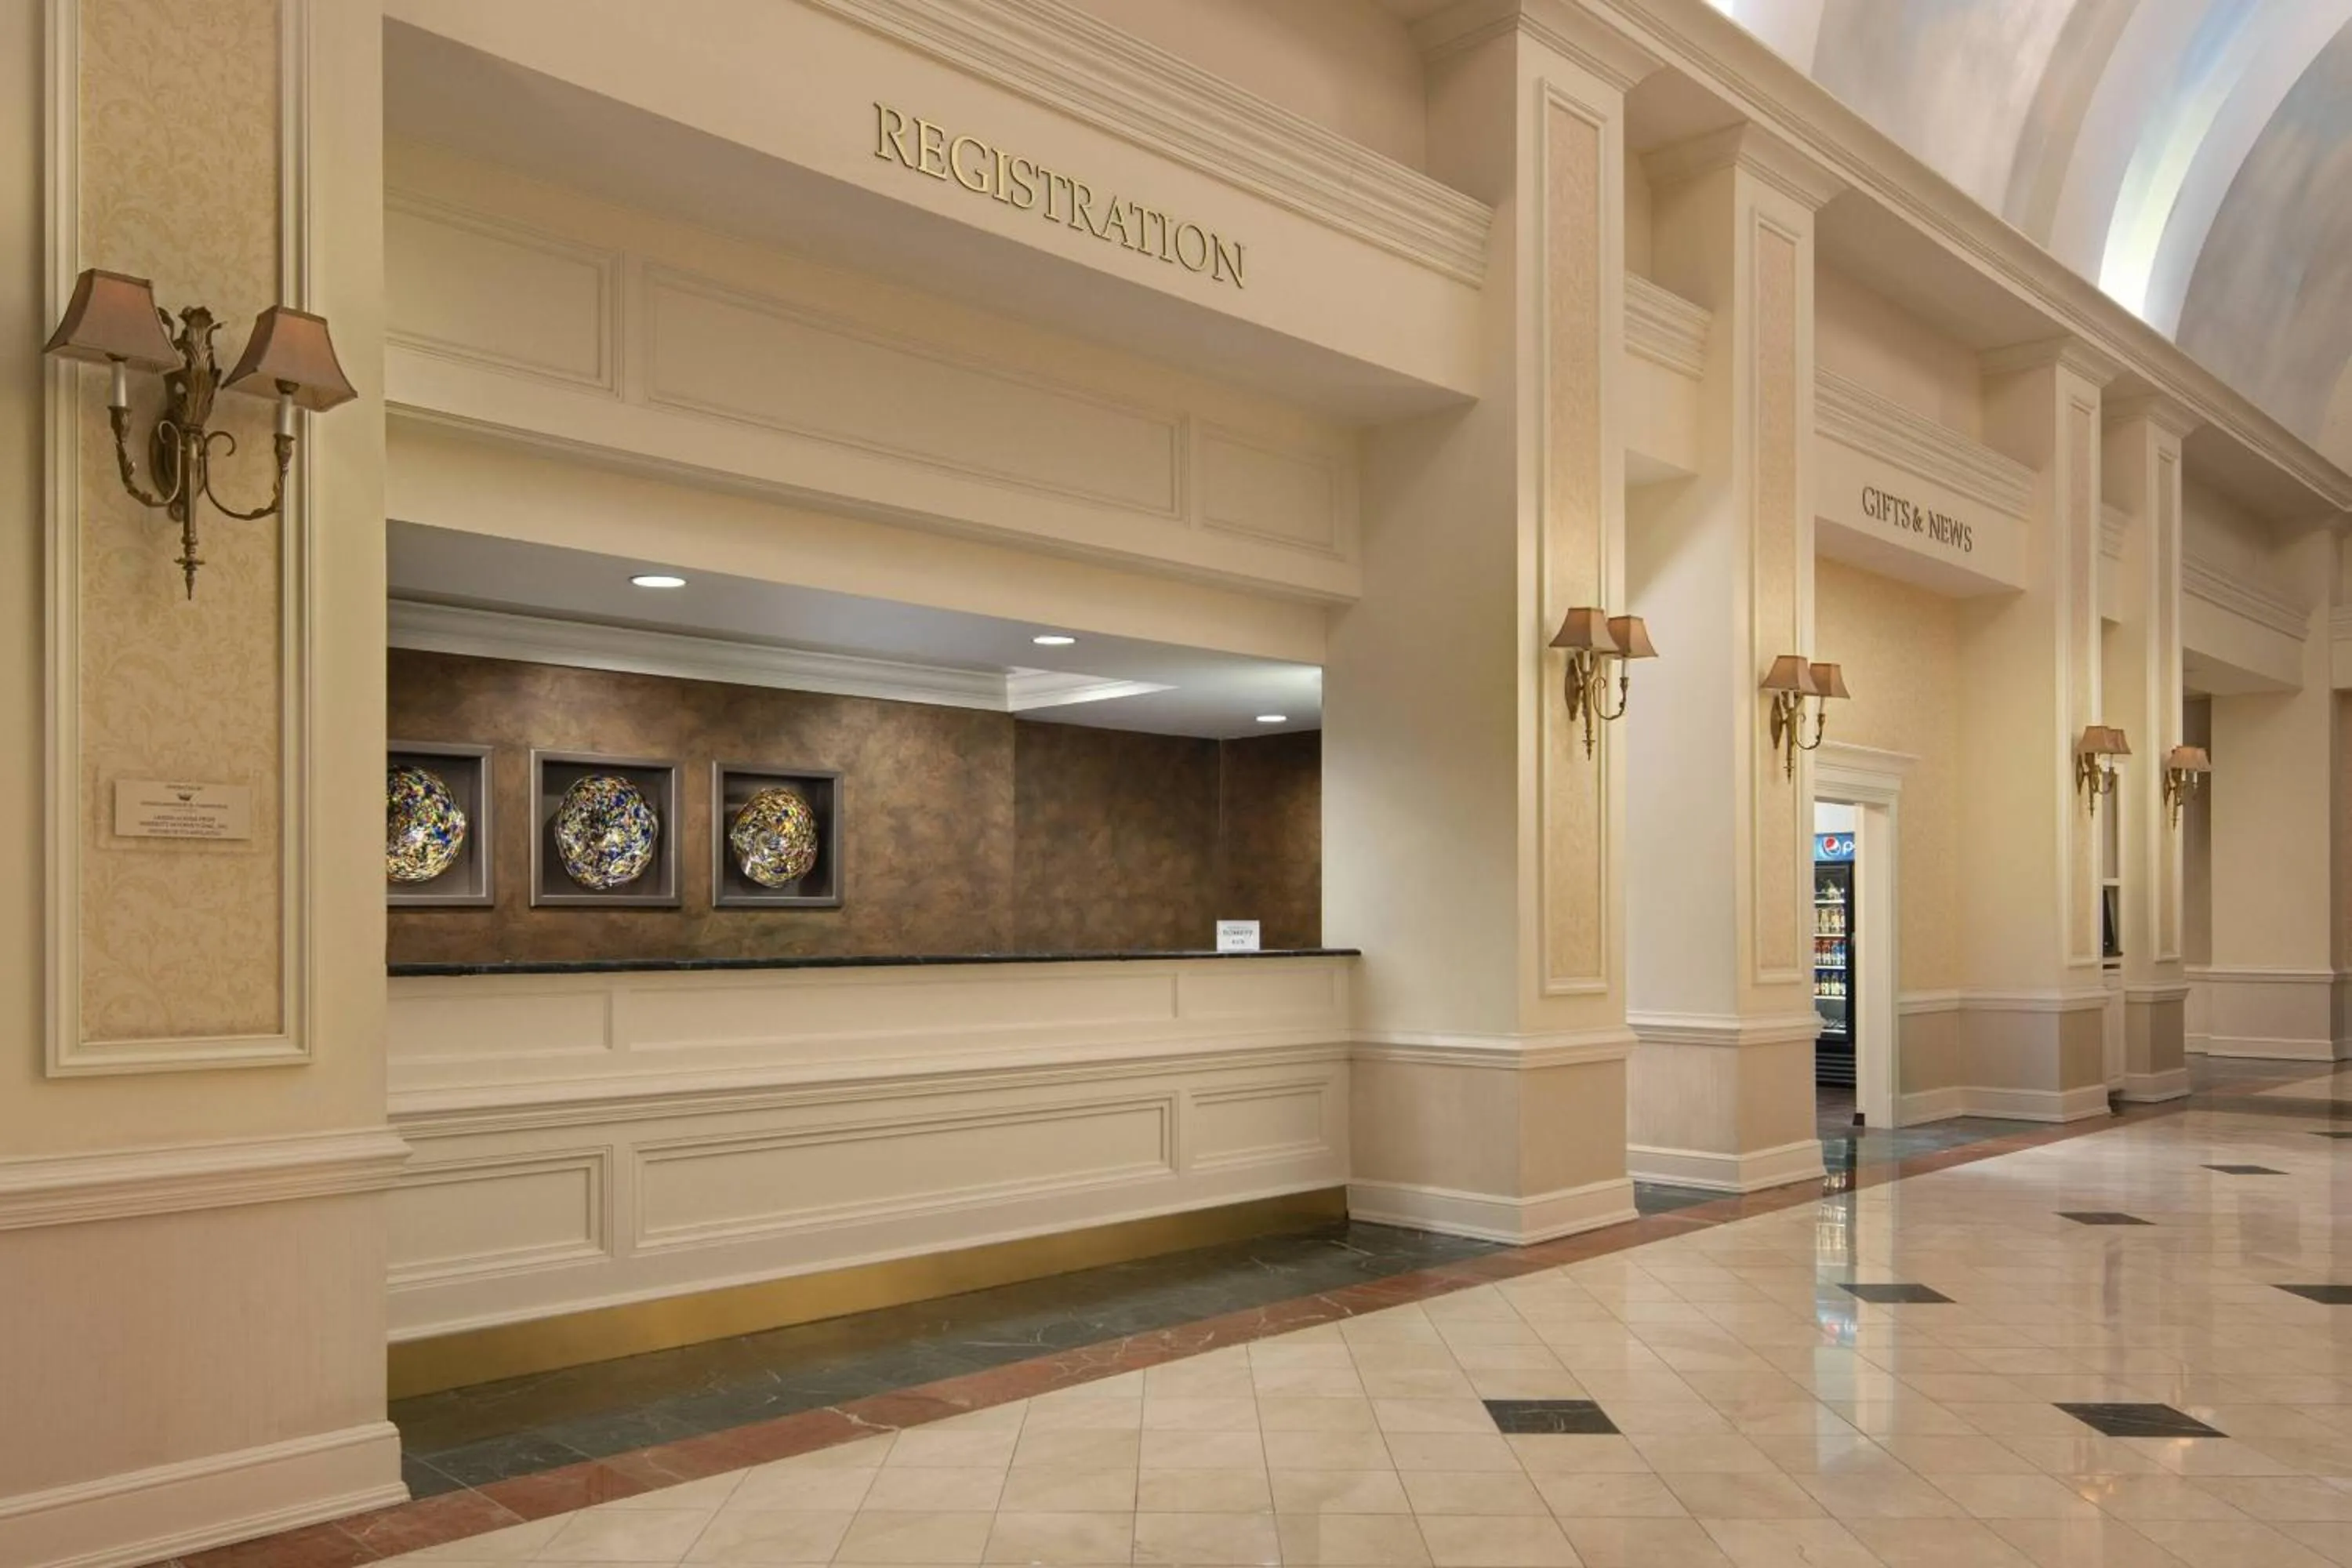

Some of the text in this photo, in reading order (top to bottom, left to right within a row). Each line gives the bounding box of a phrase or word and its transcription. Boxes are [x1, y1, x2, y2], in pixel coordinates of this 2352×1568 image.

[873, 101, 1246, 289] REGISTRATION
[1862, 486, 1973, 553] GIFTS & NEWS
